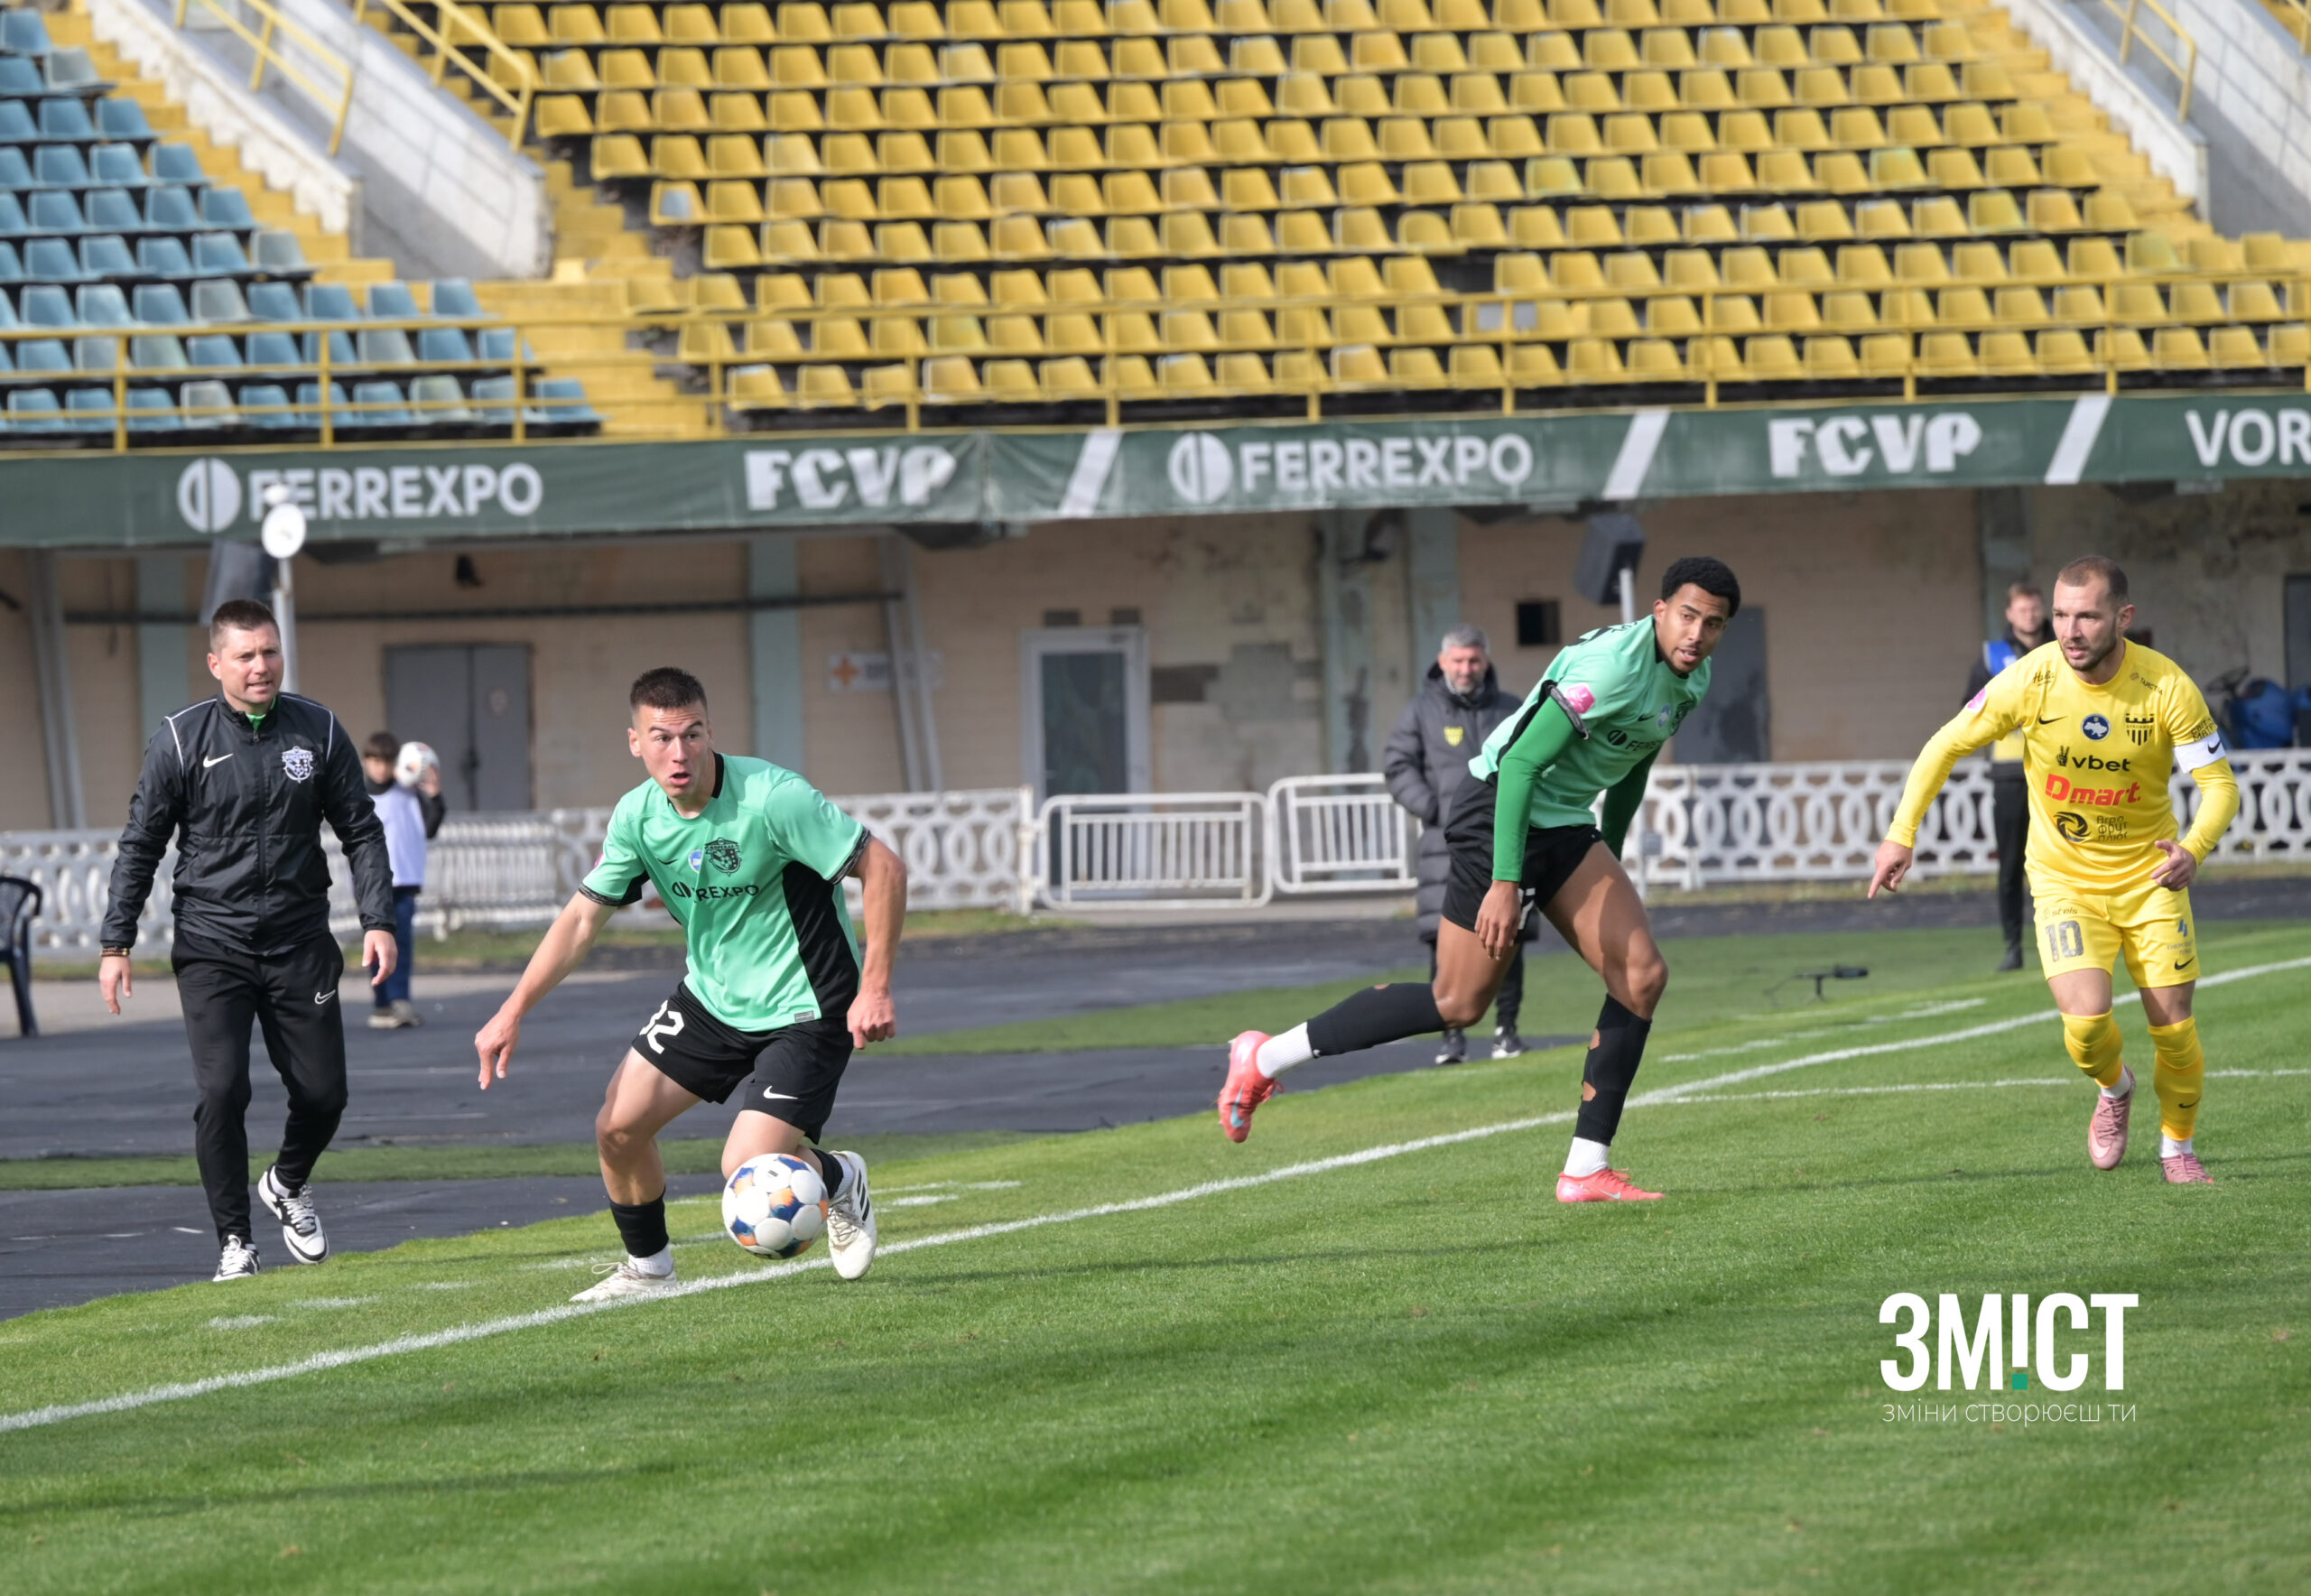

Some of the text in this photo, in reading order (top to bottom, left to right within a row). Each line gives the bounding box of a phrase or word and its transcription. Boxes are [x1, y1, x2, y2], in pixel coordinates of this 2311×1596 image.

[1239, 433, 1534, 491] FERREXPO
[1768, 413, 1982, 478] FCVP
[2185, 408, 2311, 467] VOR
[248, 462, 543, 523] FERREXPO
[744, 445, 956, 511] FCVP
[2072, 755, 2131, 772] vbet
[2045, 920, 2084, 962] 10
